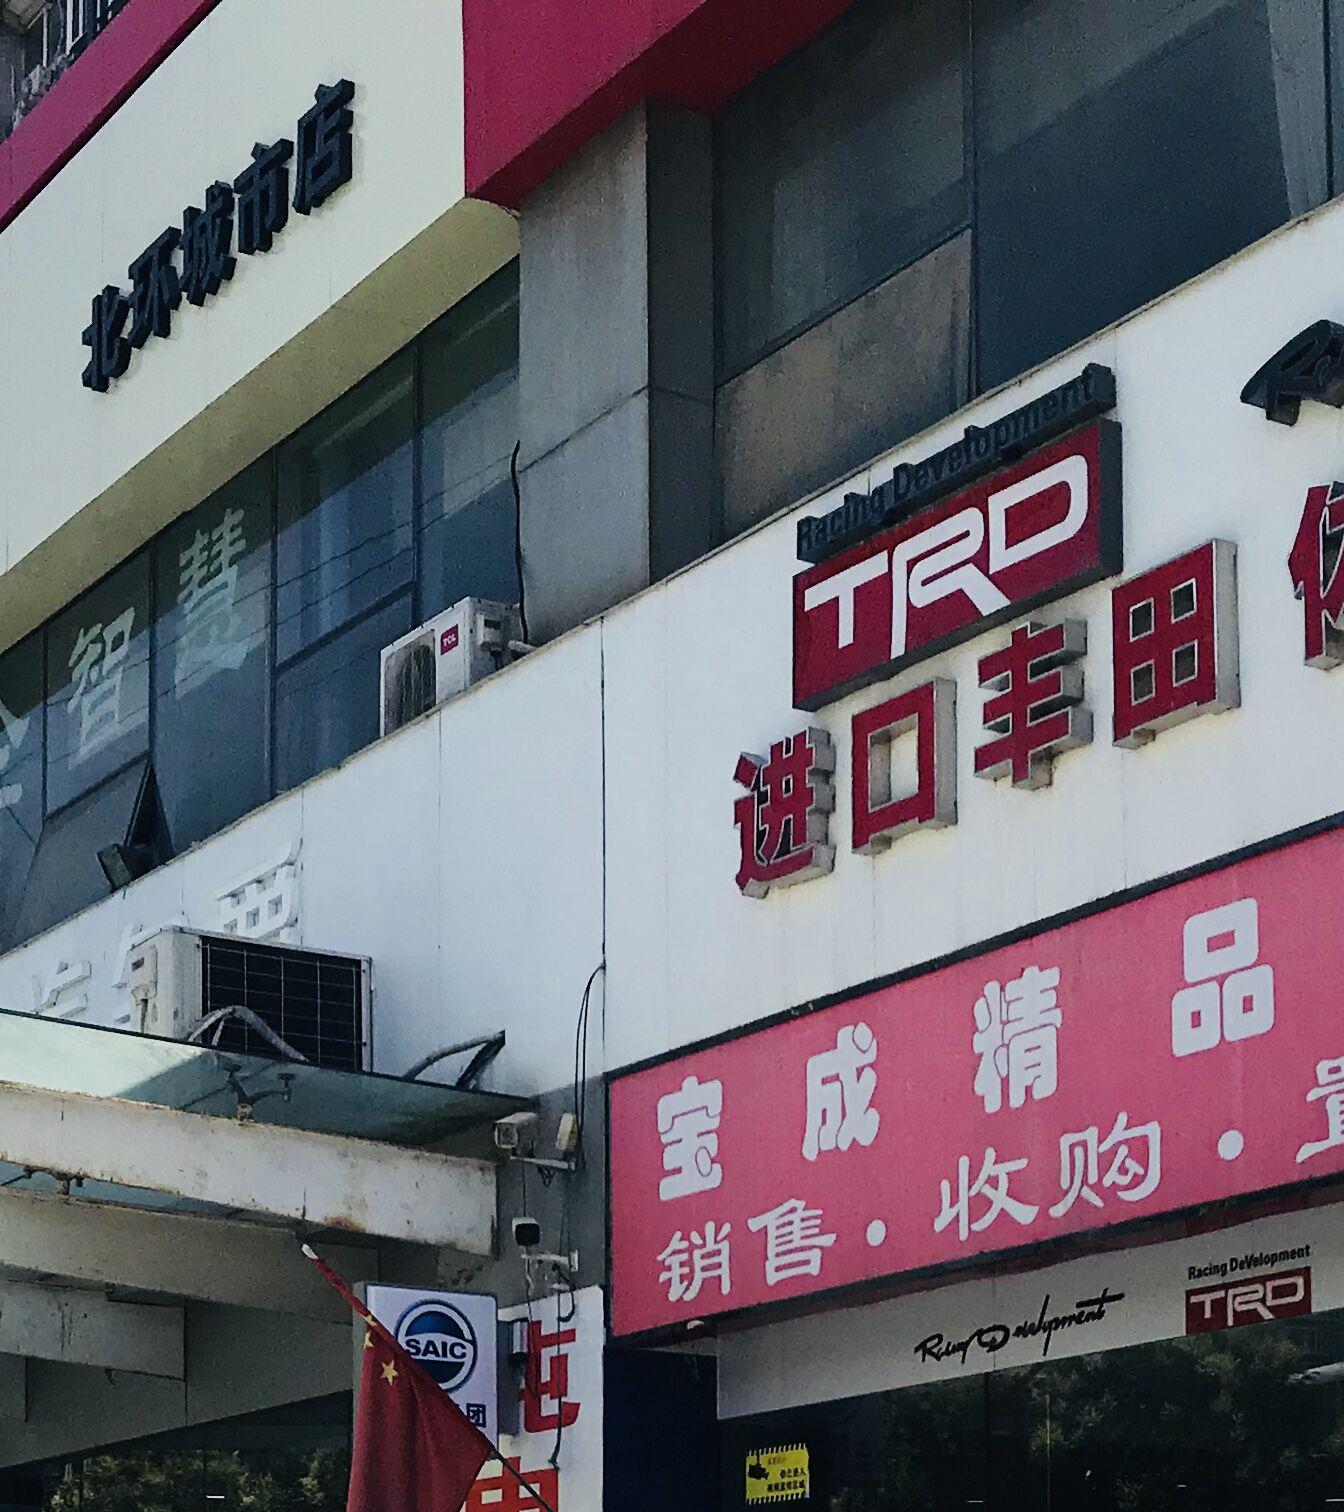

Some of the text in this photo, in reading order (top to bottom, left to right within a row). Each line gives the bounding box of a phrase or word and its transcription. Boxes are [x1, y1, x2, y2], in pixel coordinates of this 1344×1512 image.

[81, 78, 354, 392] 北环城市店
[804, 455, 1089, 659] TRD
[1188, 1259, 1227, 1281] Racing
[1190, 1276, 1305, 1328] TRD
[405, 1337, 467, 1359] SAIC
